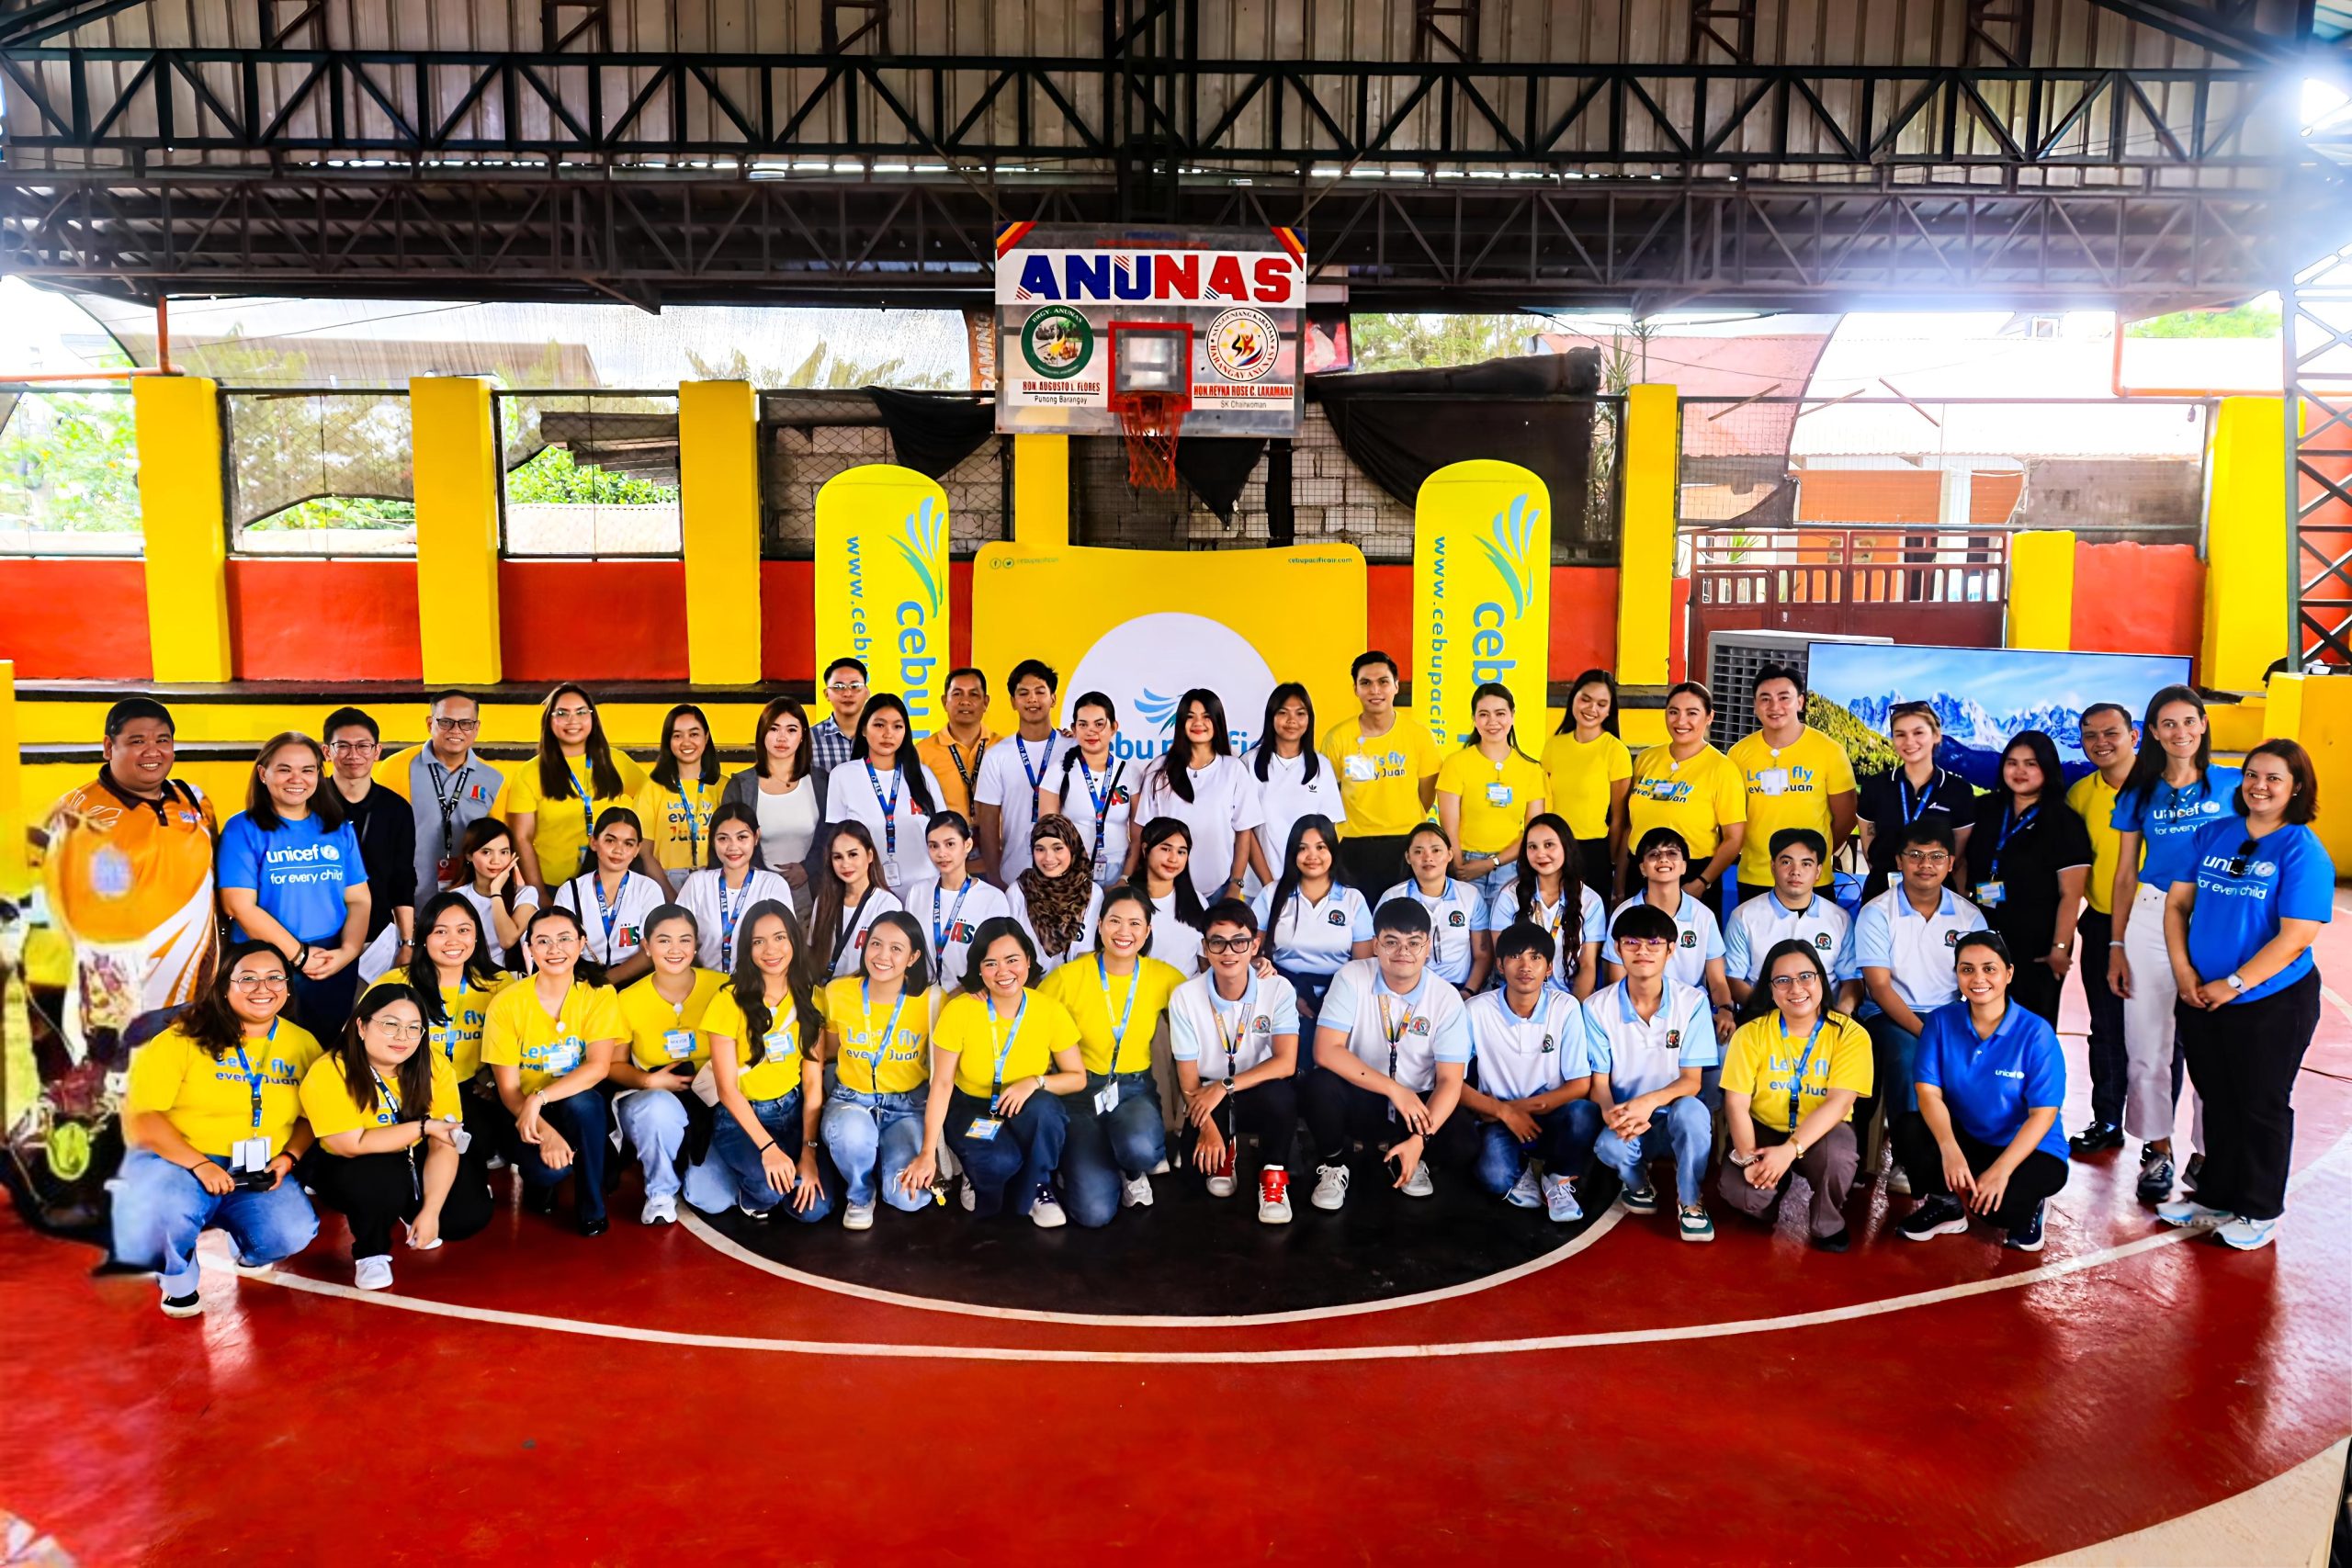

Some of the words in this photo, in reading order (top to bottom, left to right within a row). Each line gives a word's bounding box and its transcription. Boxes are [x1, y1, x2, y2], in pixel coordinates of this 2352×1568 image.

[1014, 254, 1292, 302] ANUNAS
[1039, 381, 1069, 391] AUGUSTO
[1077, 382, 1101, 392] FLORES
[1231, 386, 1249, 397] ROSE
[1035, 395, 1057, 404] Punong
[1058, 396, 1088, 405] Barangay
[1220, 400, 1229, 409] SK
[1231, 400, 1267, 409] Chairwoman
[1472, 602, 1516, 691] ceb
[896, 600, 936, 716] cebu
[1383, 768, 1406, 778] Juan
[1792, 766, 1813, 783] fly
[2154, 827, 2167, 837] for
[2169, 824, 2198, 834] every
[266, 843, 319, 863] unicef
[2203, 855, 2260, 875] unief
[270, 874, 287, 885] for
[288, 874, 319, 885] every
[320, 869, 344, 882] child
[2240, 885, 2268, 900] child
[899, 1029, 922, 1050] fly
[888, 1049, 920, 1061] Juan
[271, 1058, 296, 1078] fly
